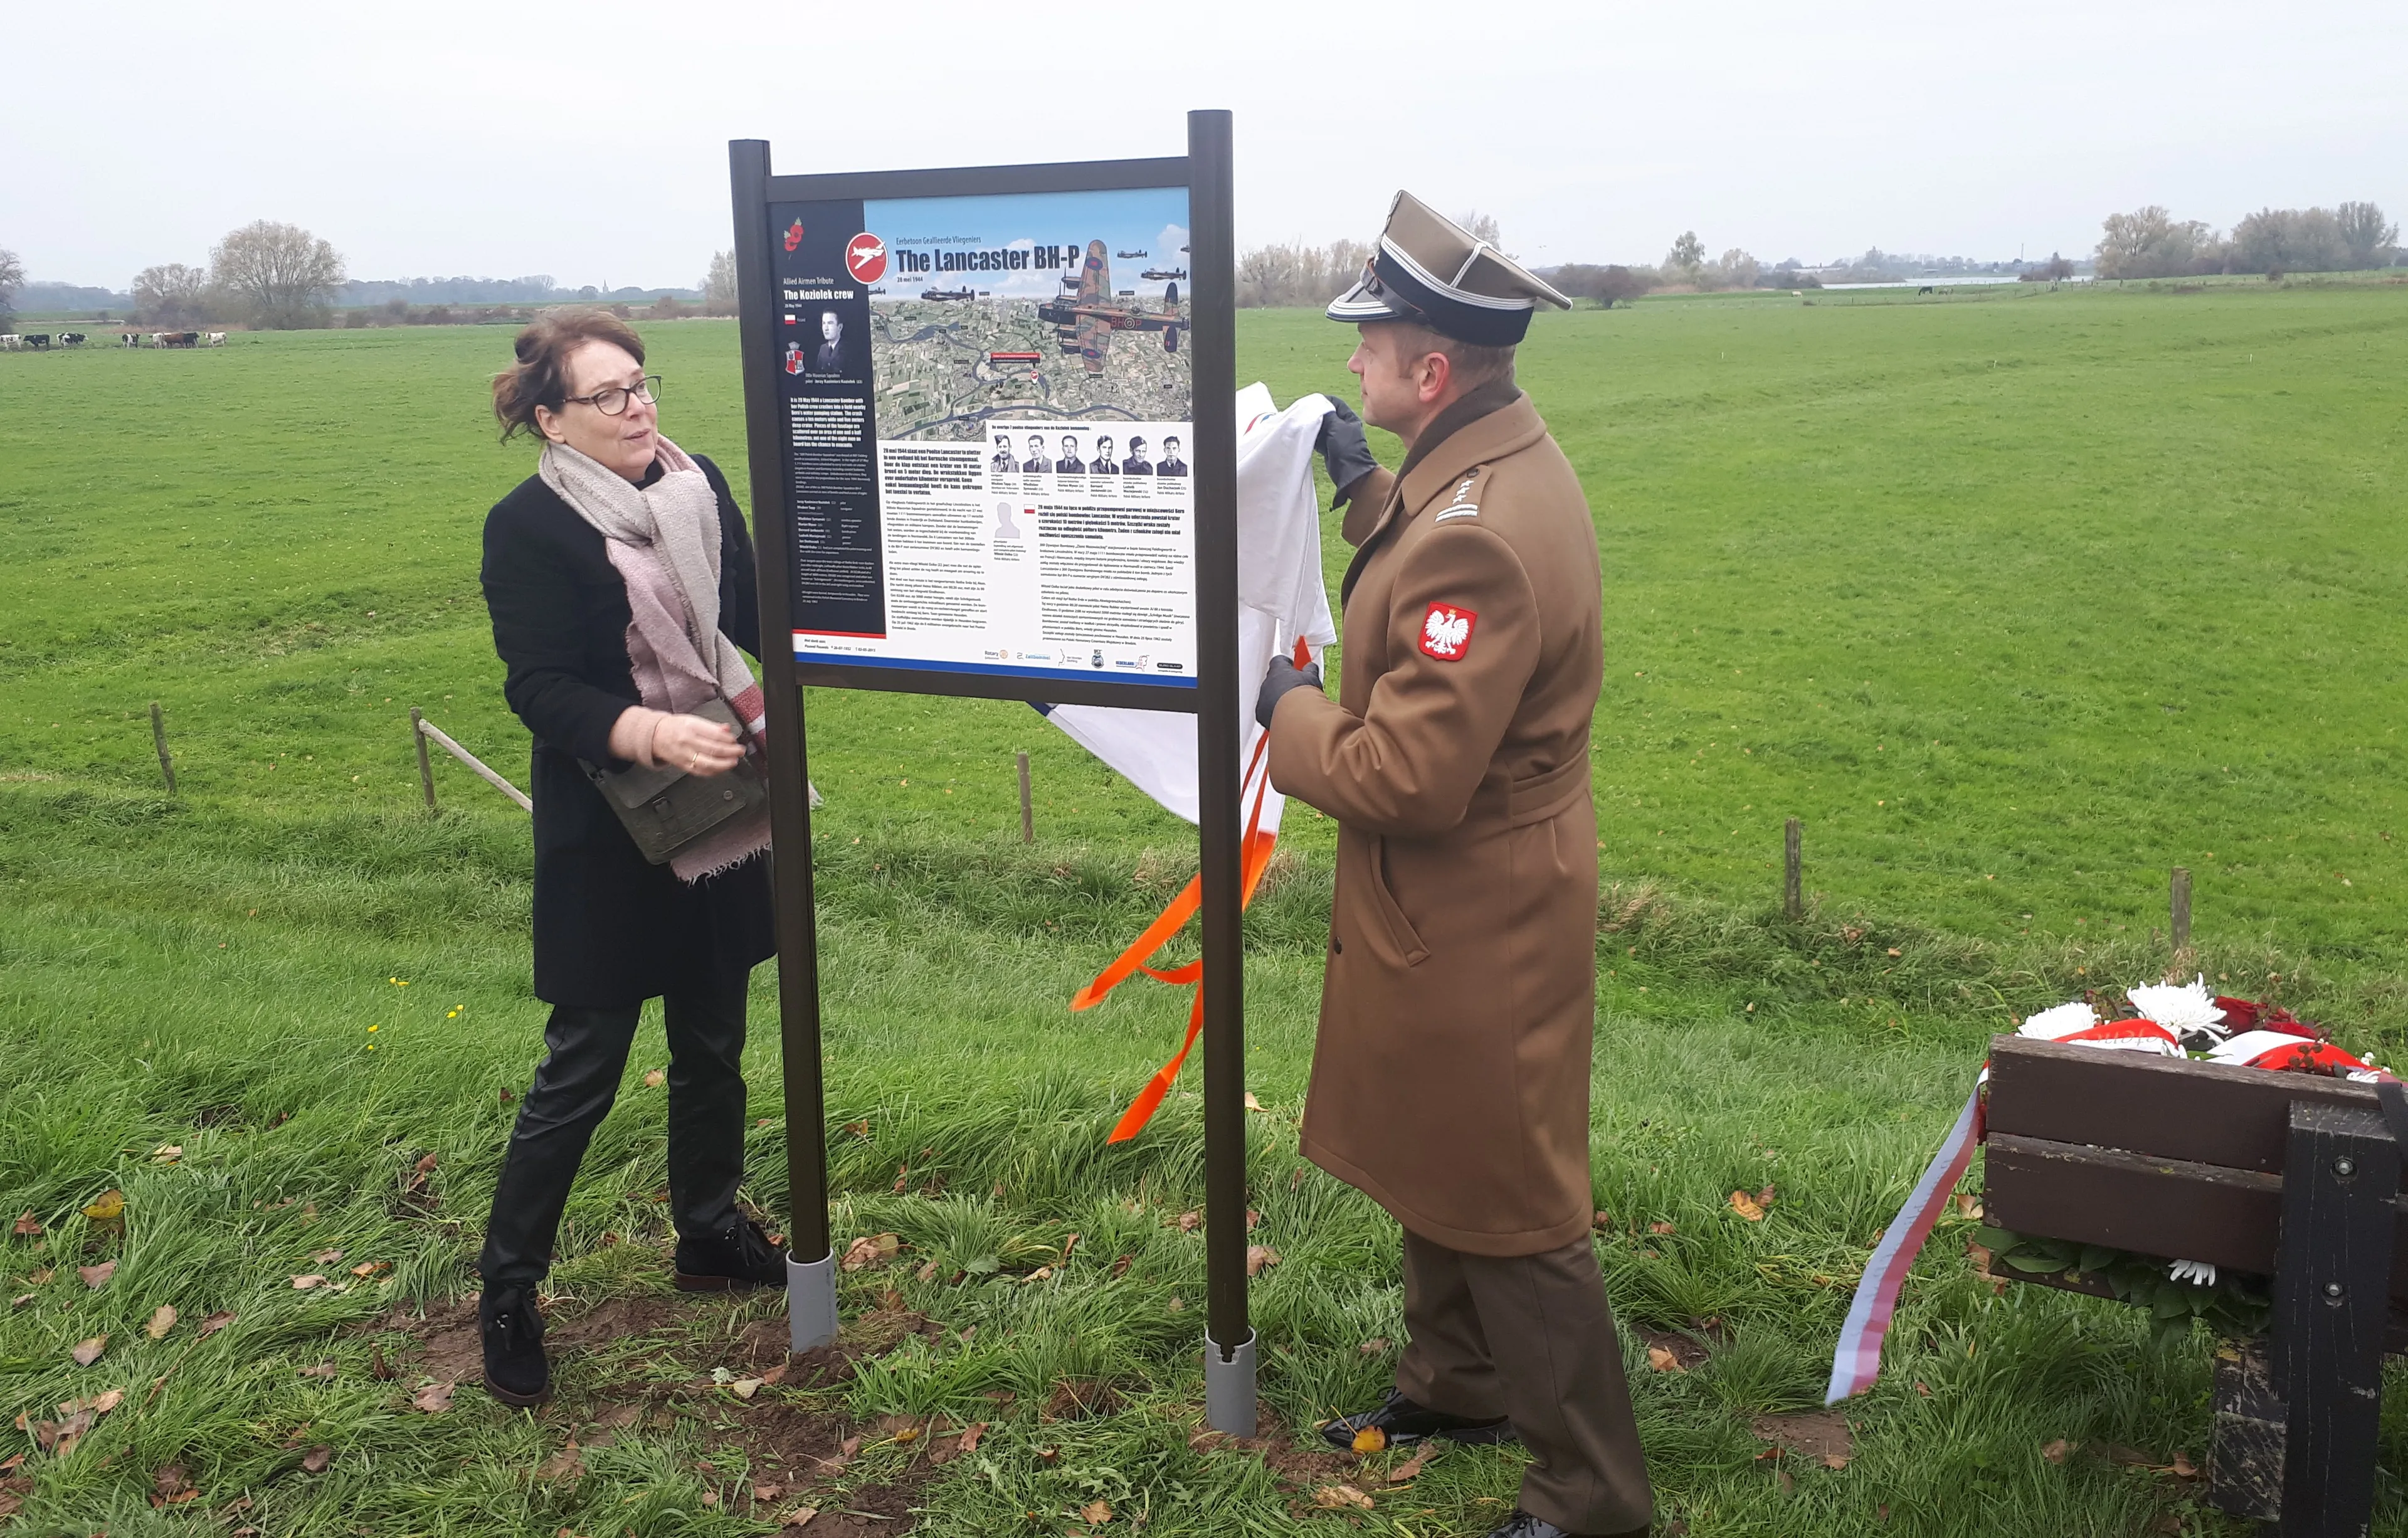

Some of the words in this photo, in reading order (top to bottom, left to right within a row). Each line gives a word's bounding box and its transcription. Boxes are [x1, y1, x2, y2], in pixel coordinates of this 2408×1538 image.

[897, 237, 922, 245] Eerbetoon
[953, 236, 981, 244] Vliegeniers
[896, 250, 930, 272] The
[935, 249, 1029, 272] Lancaster
[1034, 245, 1079, 269] BH-P
[784, 290, 798, 300] The
[800, 289, 832, 300] Koziolek
[834, 290, 853, 299] crew
